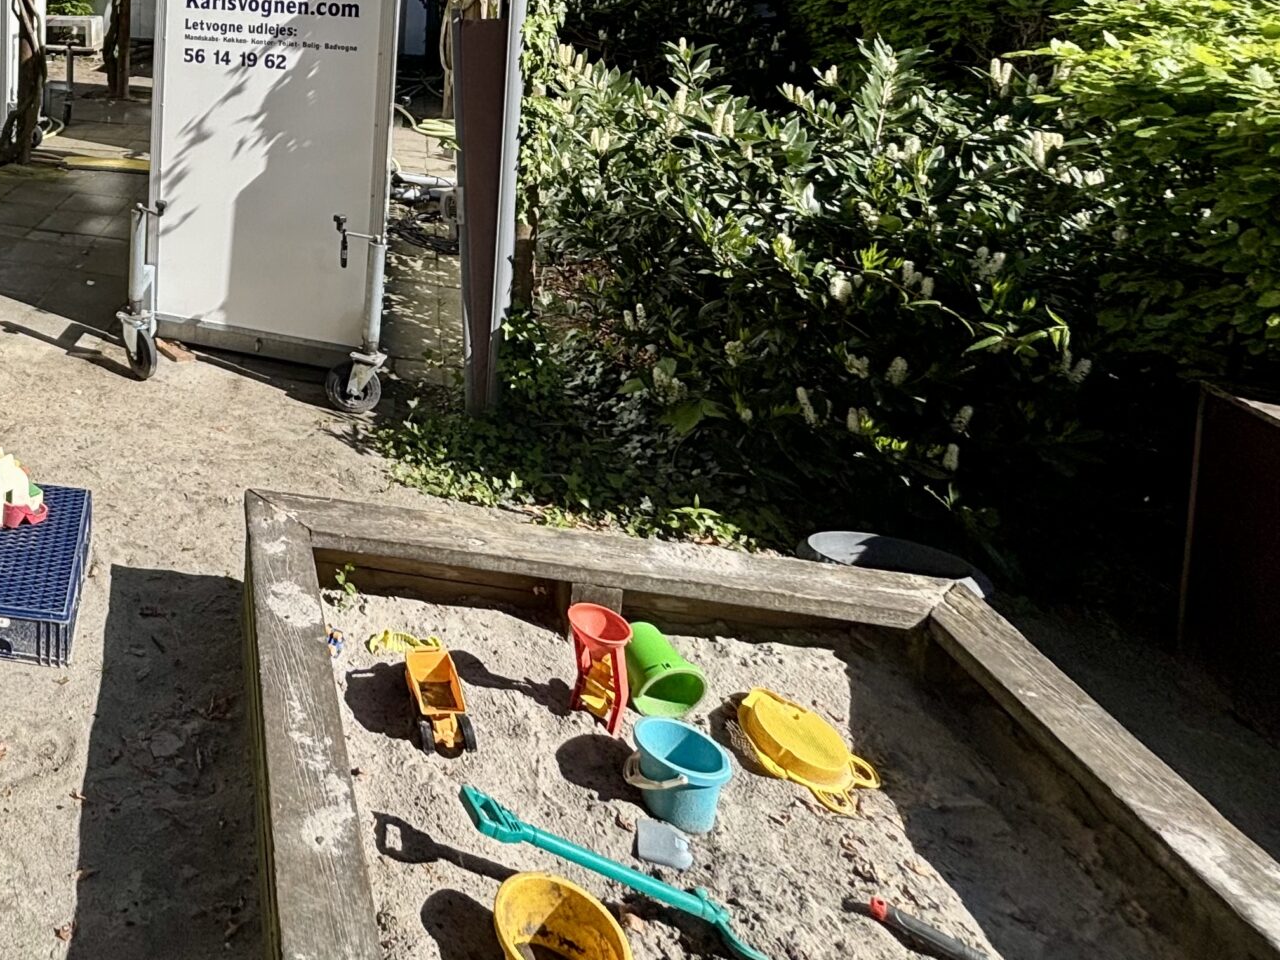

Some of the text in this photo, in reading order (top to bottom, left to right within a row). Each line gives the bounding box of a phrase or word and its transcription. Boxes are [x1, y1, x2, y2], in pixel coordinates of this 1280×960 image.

[184, 18, 298, 38] Letvogne udlejes:
[183, 47, 287, 70] 56 14 19 62
